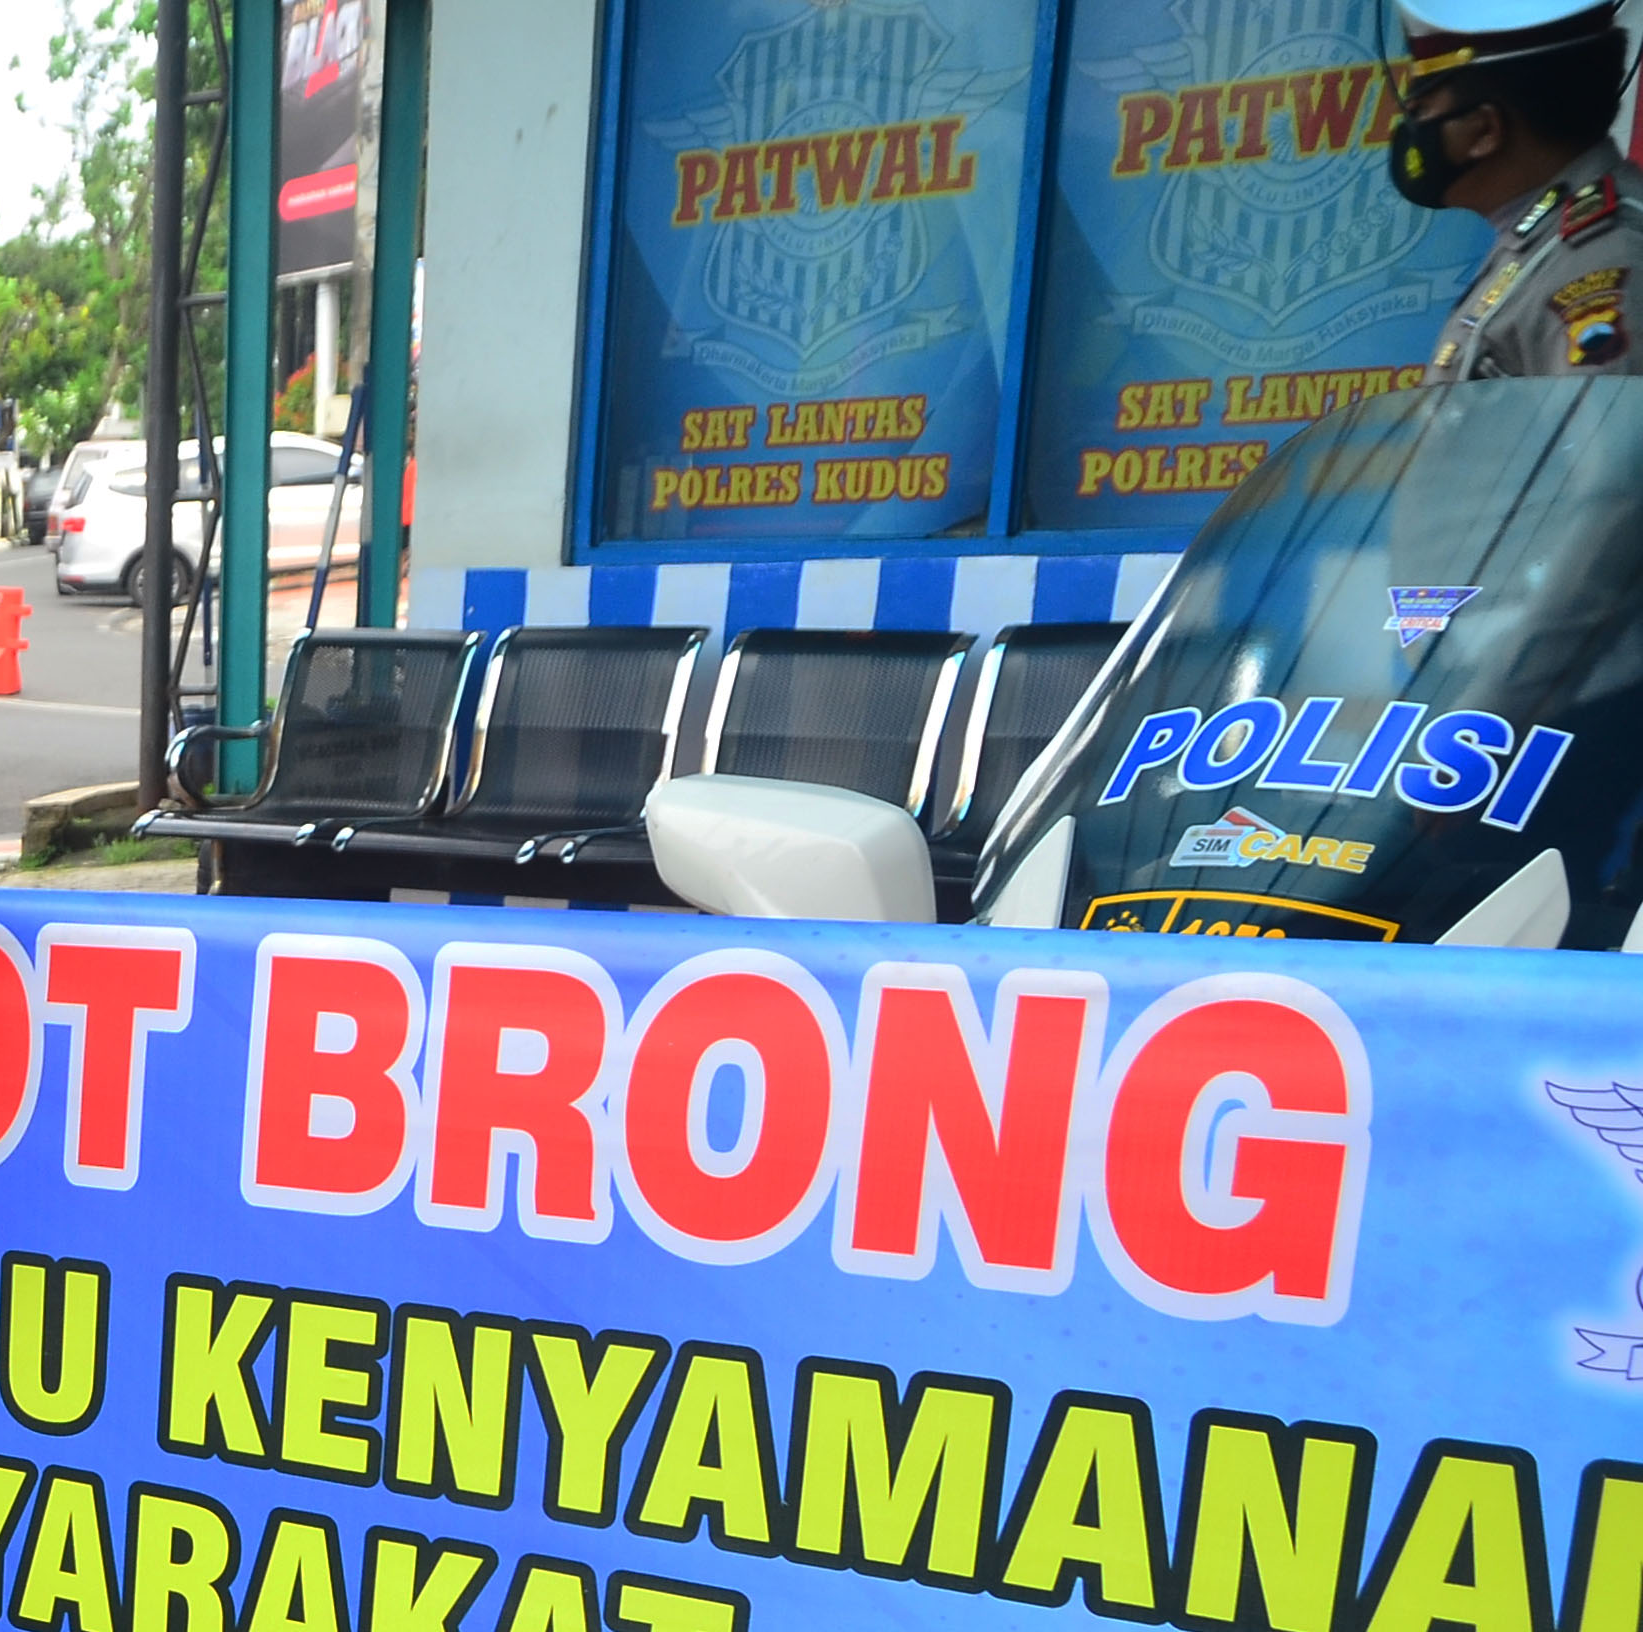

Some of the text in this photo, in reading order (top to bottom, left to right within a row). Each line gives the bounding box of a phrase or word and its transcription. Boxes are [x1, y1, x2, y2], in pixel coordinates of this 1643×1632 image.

[1113, 60, 1413, 177] PATWA
[672, 115, 977, 228] PATWAL
[681, 395, 926, 451] SAT LANTAS
[1117, 380, 1211, 430] SAT
[651, 455, 949, 511] POLRES KUDUS
[1099, 696, 1575, 833] POLISI
[1192, 830, 1375, 874] SIM CARE
[250, 953, 1350, 1302] BRONG
